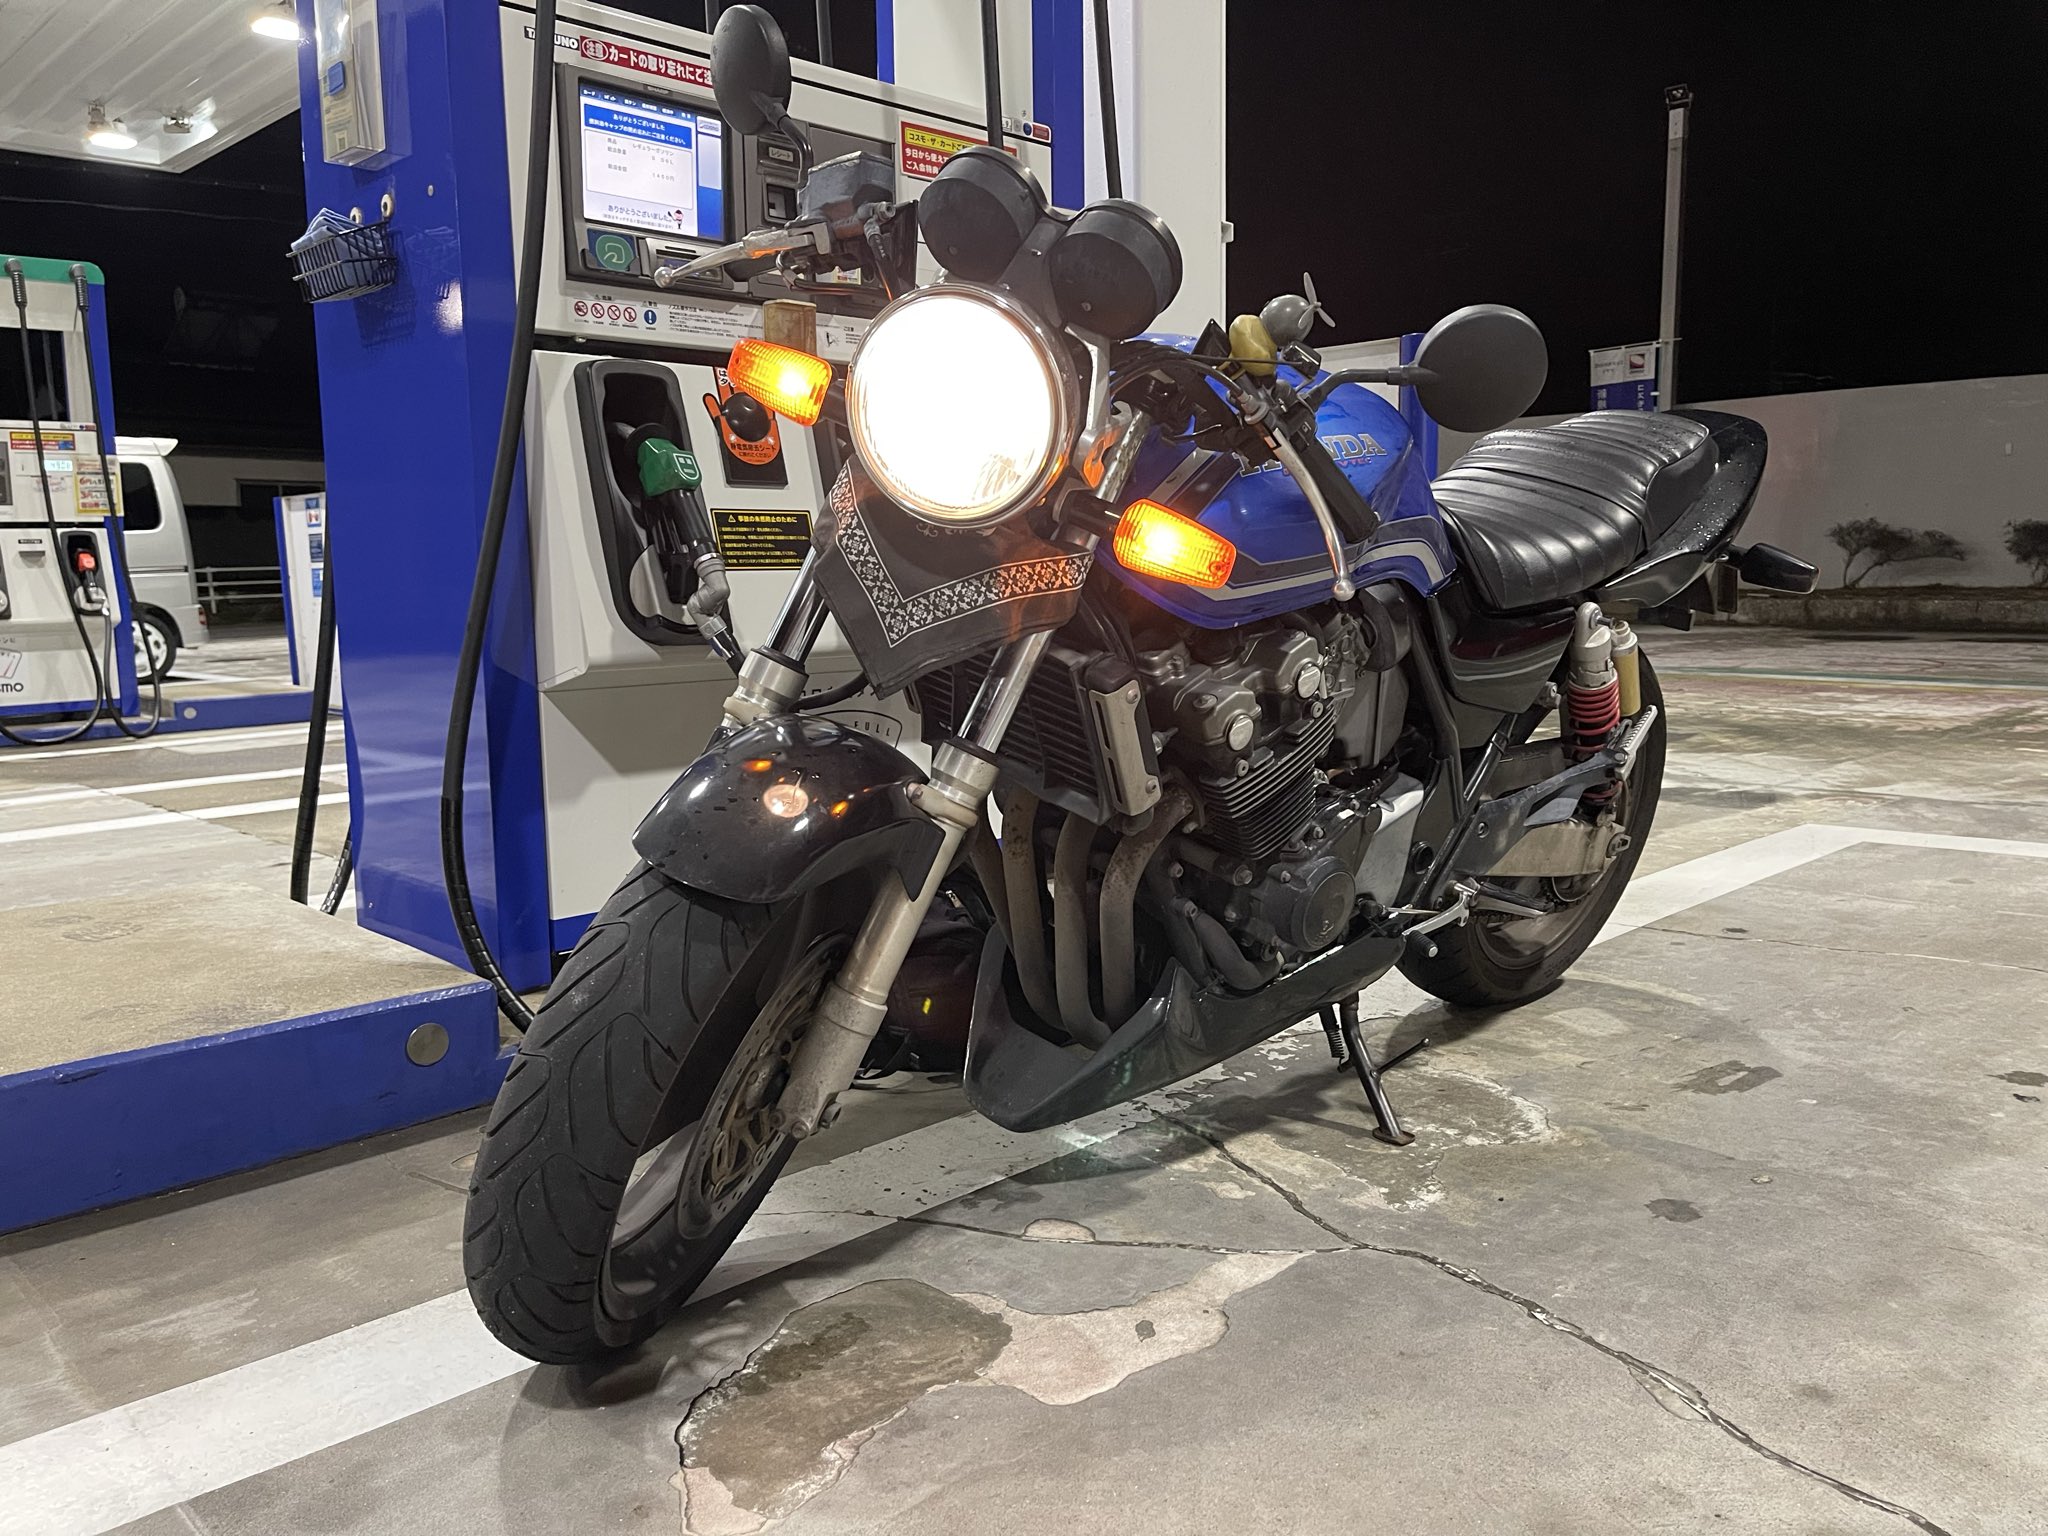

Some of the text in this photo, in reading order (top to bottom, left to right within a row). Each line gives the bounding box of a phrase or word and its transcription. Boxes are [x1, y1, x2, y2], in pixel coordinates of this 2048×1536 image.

[526, 28, 578, 49] TUNO
[1231, 433, 1387, 478] HNDA
[1336, 457, 1372, 468] VTEC
[854, 720, 890, 737] FULL
